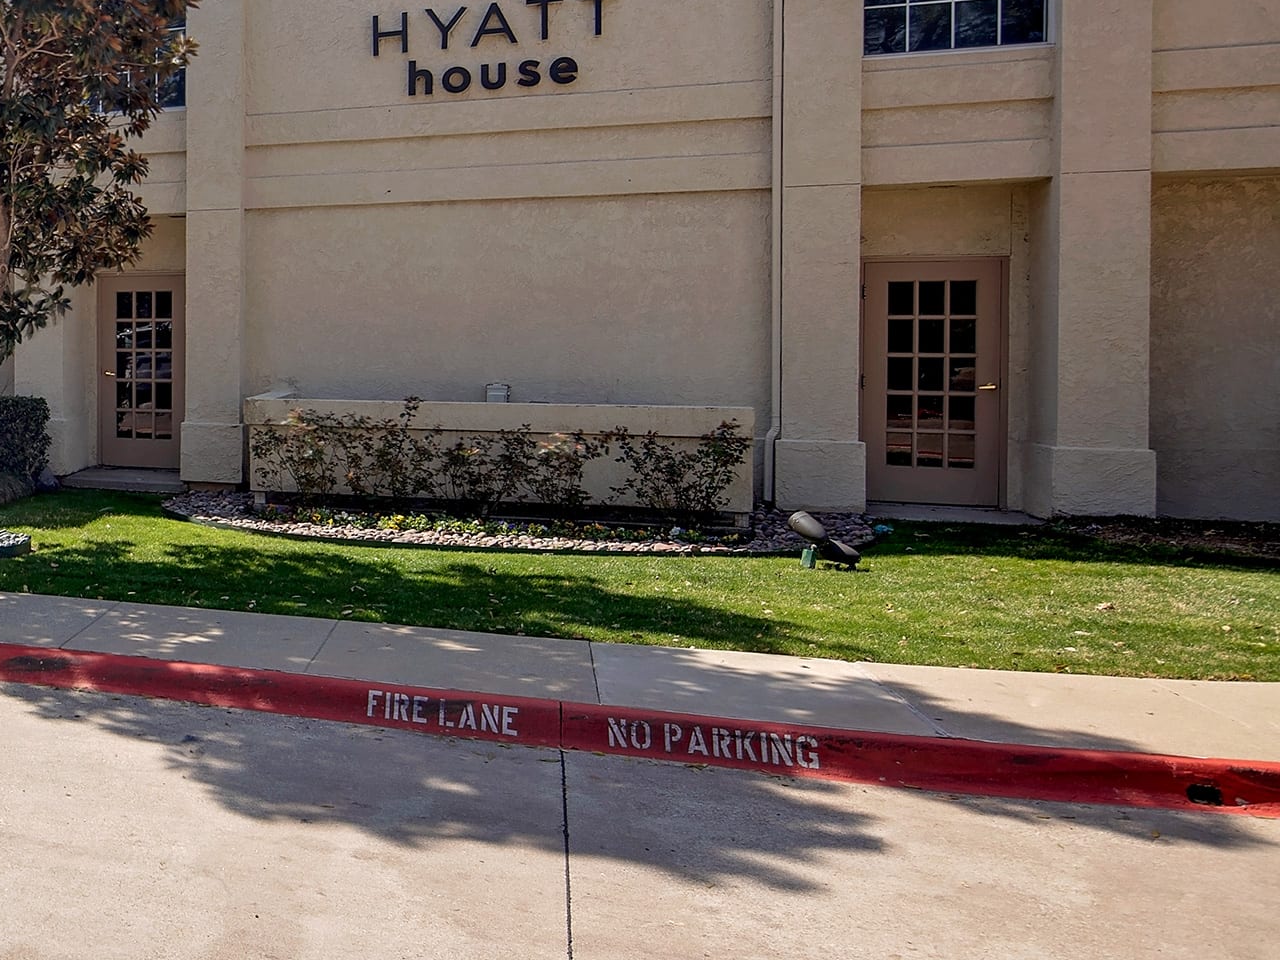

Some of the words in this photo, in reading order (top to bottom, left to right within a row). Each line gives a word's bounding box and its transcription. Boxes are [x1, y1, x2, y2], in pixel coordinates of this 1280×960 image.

[408, 56, 579, 96] house
[366, 689, 429, 724] FIRE
[438, 698, 519, 736] LANE
[607, 717, 652, 750] NO
[664, 722, 820, 770] PARKING
